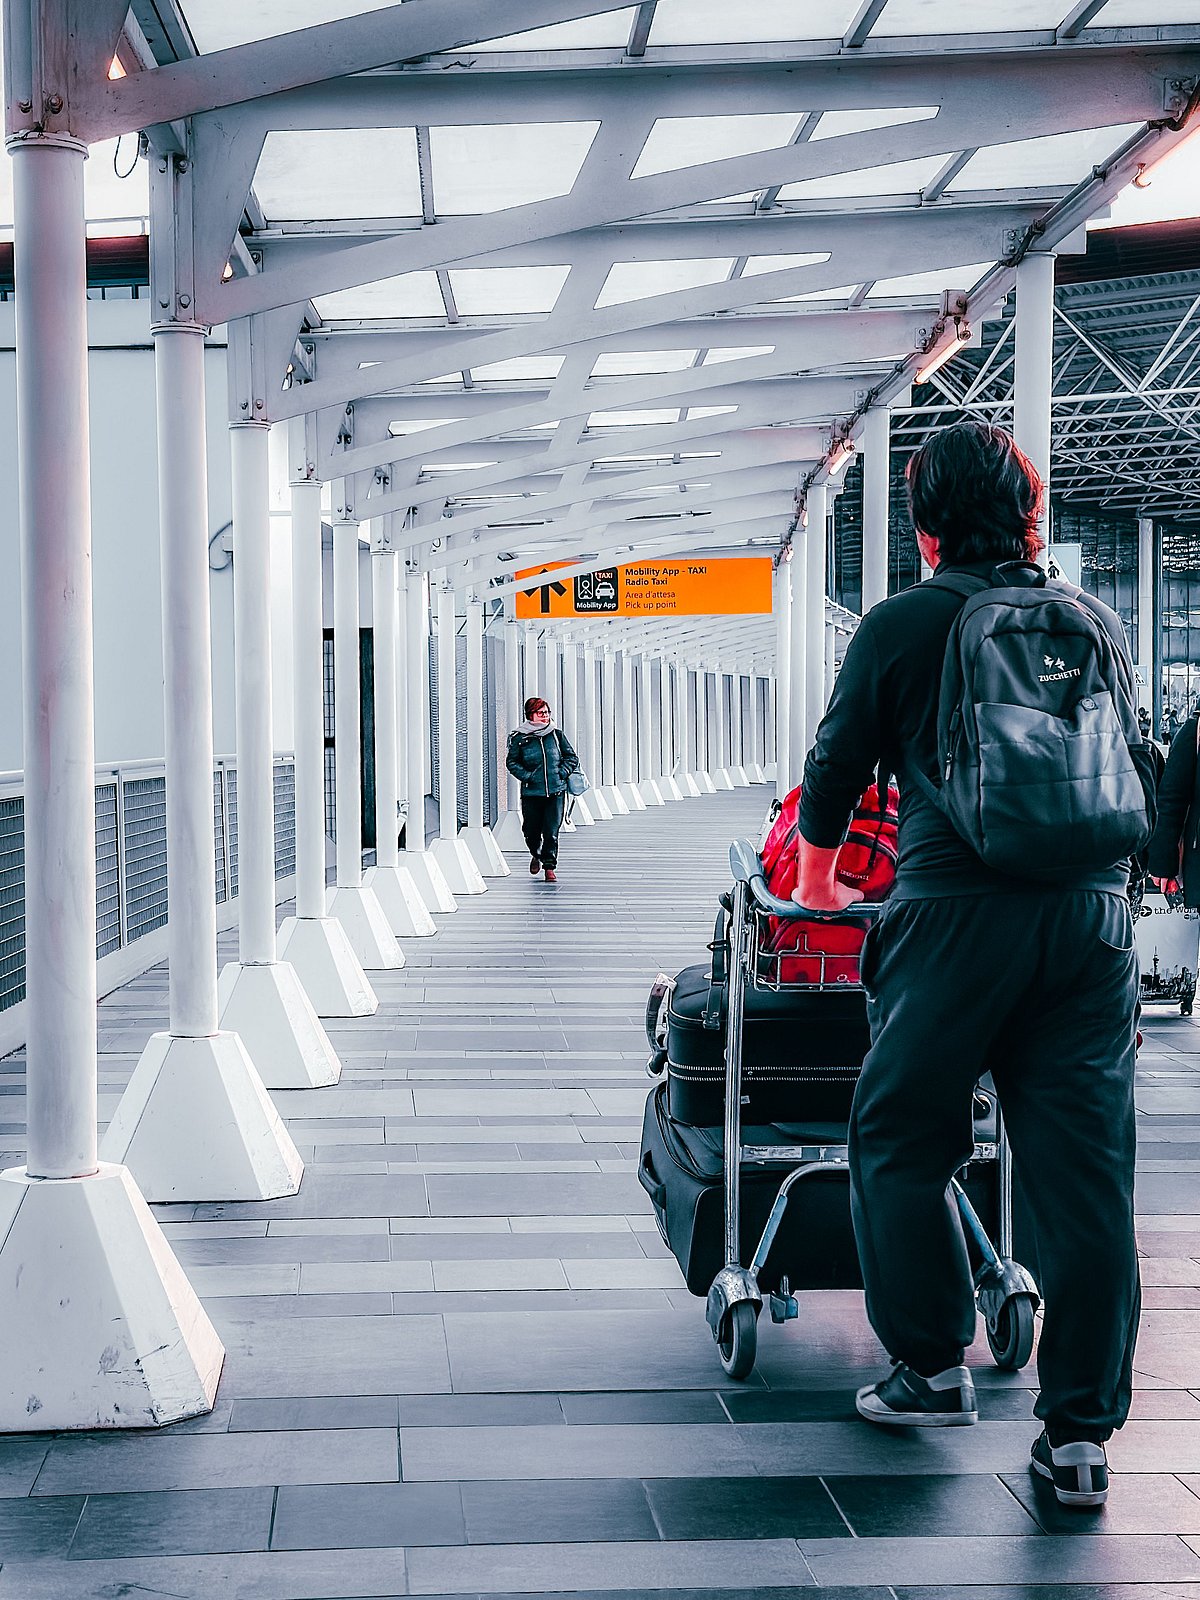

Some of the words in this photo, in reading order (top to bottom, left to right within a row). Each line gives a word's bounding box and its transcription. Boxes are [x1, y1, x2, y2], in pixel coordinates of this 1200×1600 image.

[625, 568, 660, 577] Mobility
[662, 568, 680, 577] App
[688, 567, 707, 575] TAXI
[625, 577, 649, 586] Radio
[651, 577, 668, 586] Taxi
[625, 591, 643, 599] Area
[645, 591, 676, 599] d'attesa
[576, 602, 602, 610] Mobility
[603, 602, 617, 610] App
[625, 601, 641, 609] Pick
[643, 602, 654, 610] up
[656, 601, 677, 610] point
[1038, 667, 1081, 682] ZUCCHETTI
[1154, 906, 1172, 914] the
